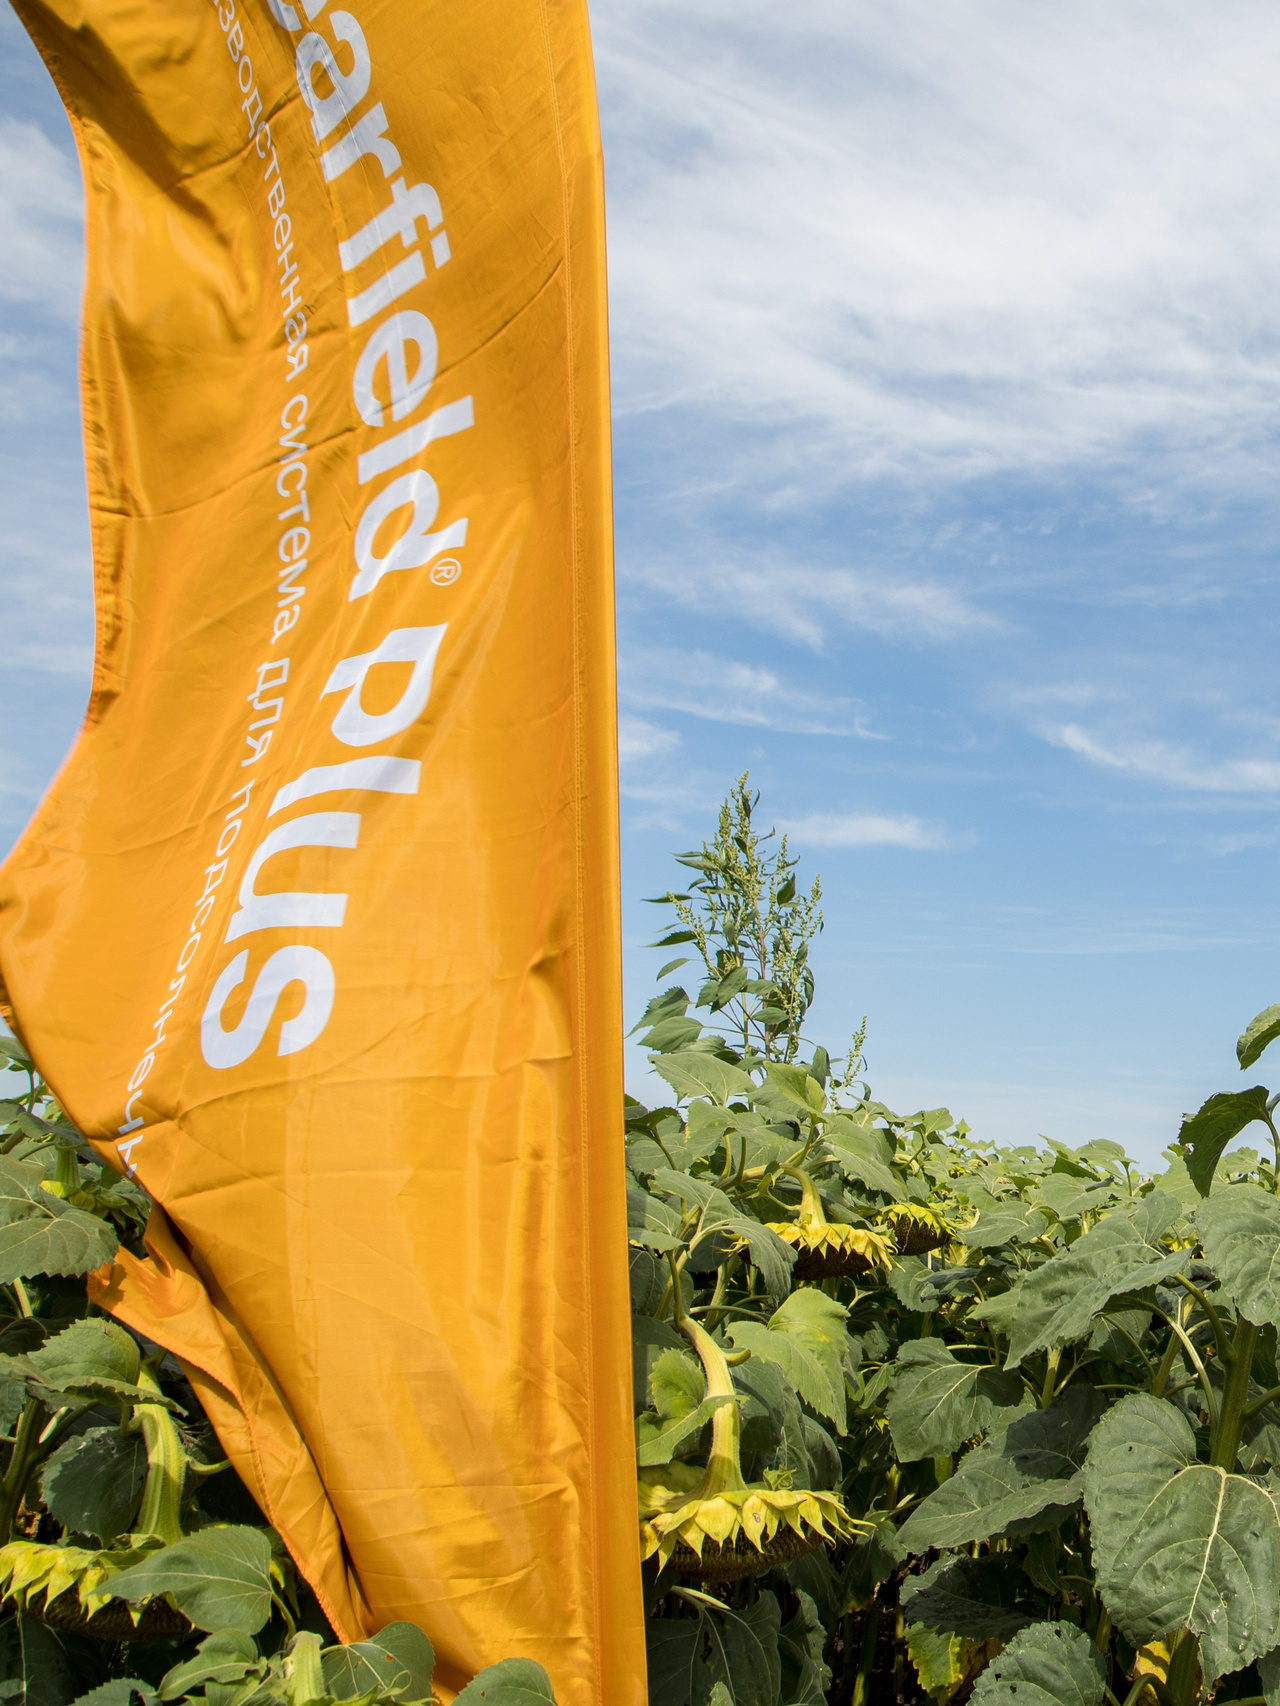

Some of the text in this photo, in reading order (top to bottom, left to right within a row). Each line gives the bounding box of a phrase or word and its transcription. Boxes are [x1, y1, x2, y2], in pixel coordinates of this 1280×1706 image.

[213, 0, 311, 384] зводственная
[200, 0, 474, 1070] arfield® Plus
[271, 393, 312, 645] система
[241, 658, 291, 768] для
